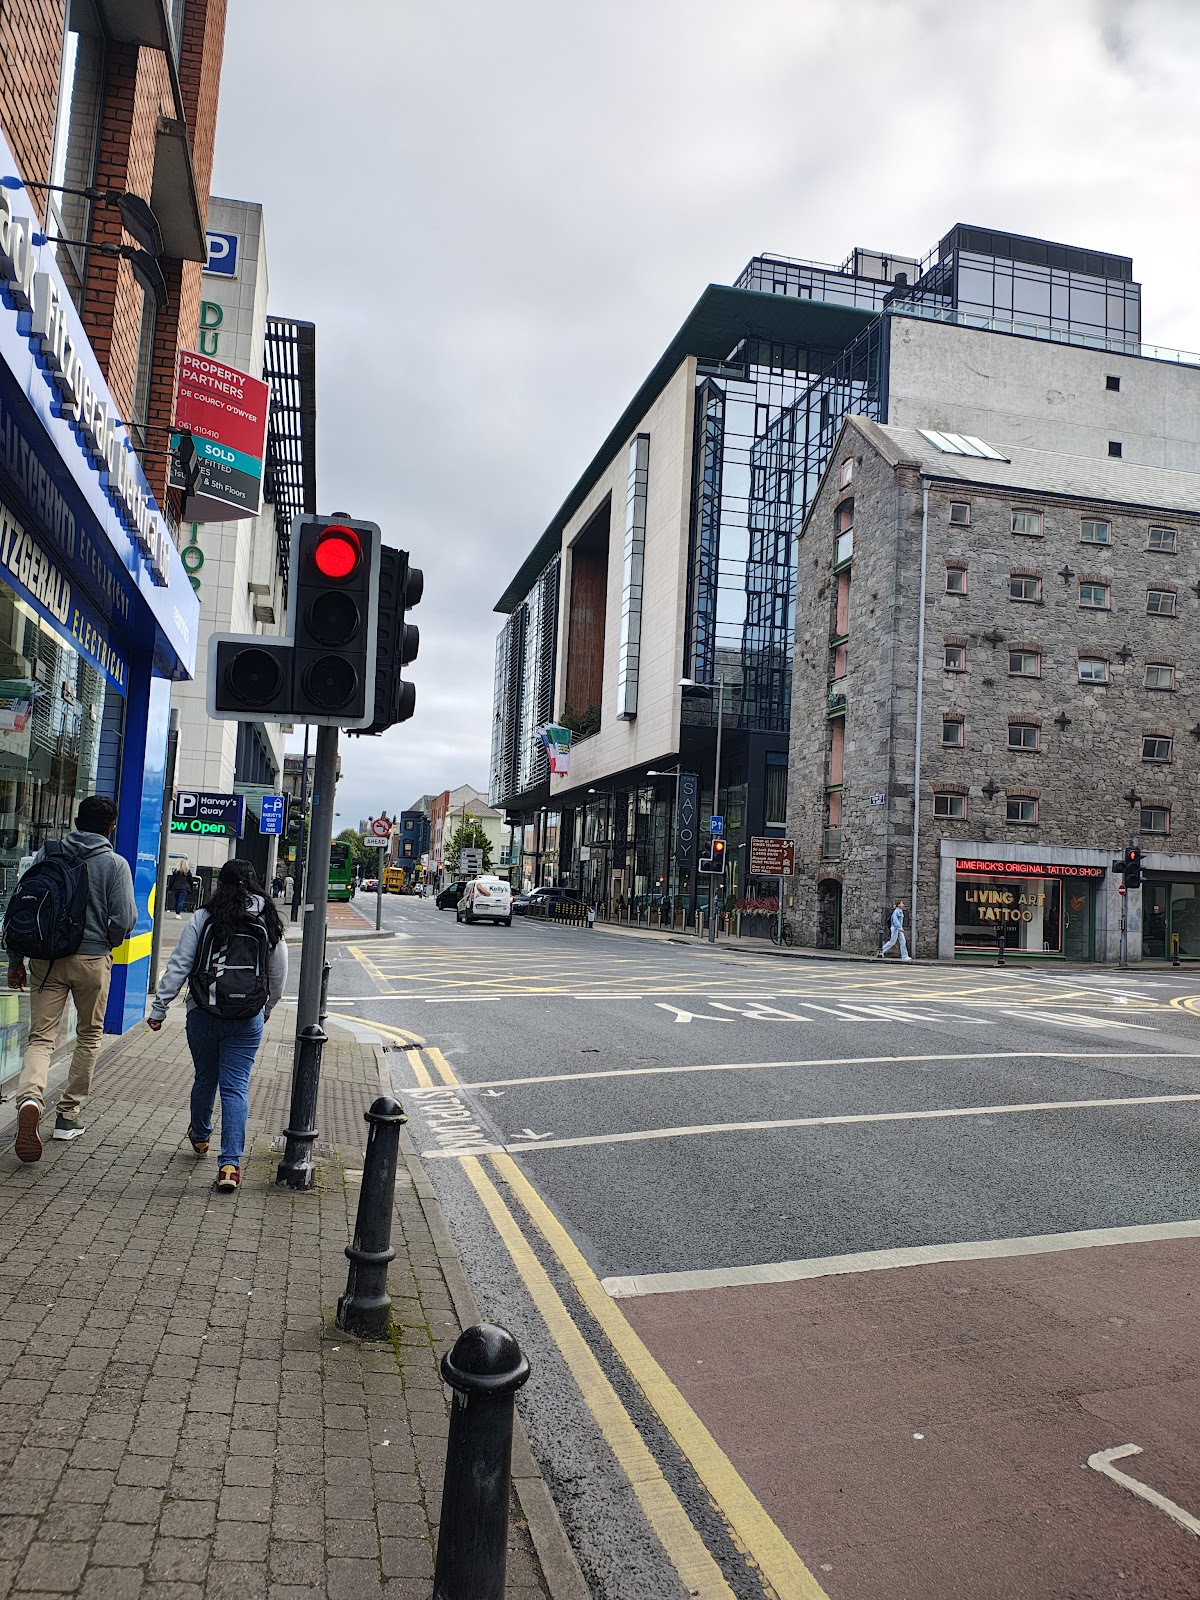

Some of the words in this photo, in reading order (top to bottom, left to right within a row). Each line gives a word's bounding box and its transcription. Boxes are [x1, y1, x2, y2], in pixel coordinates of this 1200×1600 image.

[203, 235, 230, 268] P
[183, 355, 246, 387] PROPERTY
[182, 368, 244, 400] PARTNERS
[180, 388, 192, 398] DE
[194, 392, 226, 409] COURCY
[226, 404, 258, 423] O'DWYER
[32, 272, 117, 473] Fitzgerald
[109, 441, 158, 561] Electrical
[178, 420, 192, 430] 061
[194, 425, 220, 439] 410410
[204, 444, 236, 462] SOLD
[204, 458, 232, 474] FITTED
[204, 477, 210, 486] &
[211, 480, 224, 490] 5th
[224, 484, 246, 499] Floors
[72, 608, 124, 686] ELECTRICAL
[178, 794, 197, 814] P
[200, 796, 237, 808] Harvey's
[200, 806, 224, 816] Quay
[190, 820, 226, 835] Open
[680, 783, 694, 856] SAVOY
[956, 860, 1004, 872] LIMERICK'S
[1006, 863, 1046, 874] ORIGINAL
[1046, 865, 1078, 876] TATTOO
[1079, 868, 1102, 876] SHOP
[966, 890, 1014, 906] LIVING
[1018, 893, 1046, 908] ART
[978, 906, 1034, 922] TATTOO
[655, 1002, 997, 1024] ENTRY
